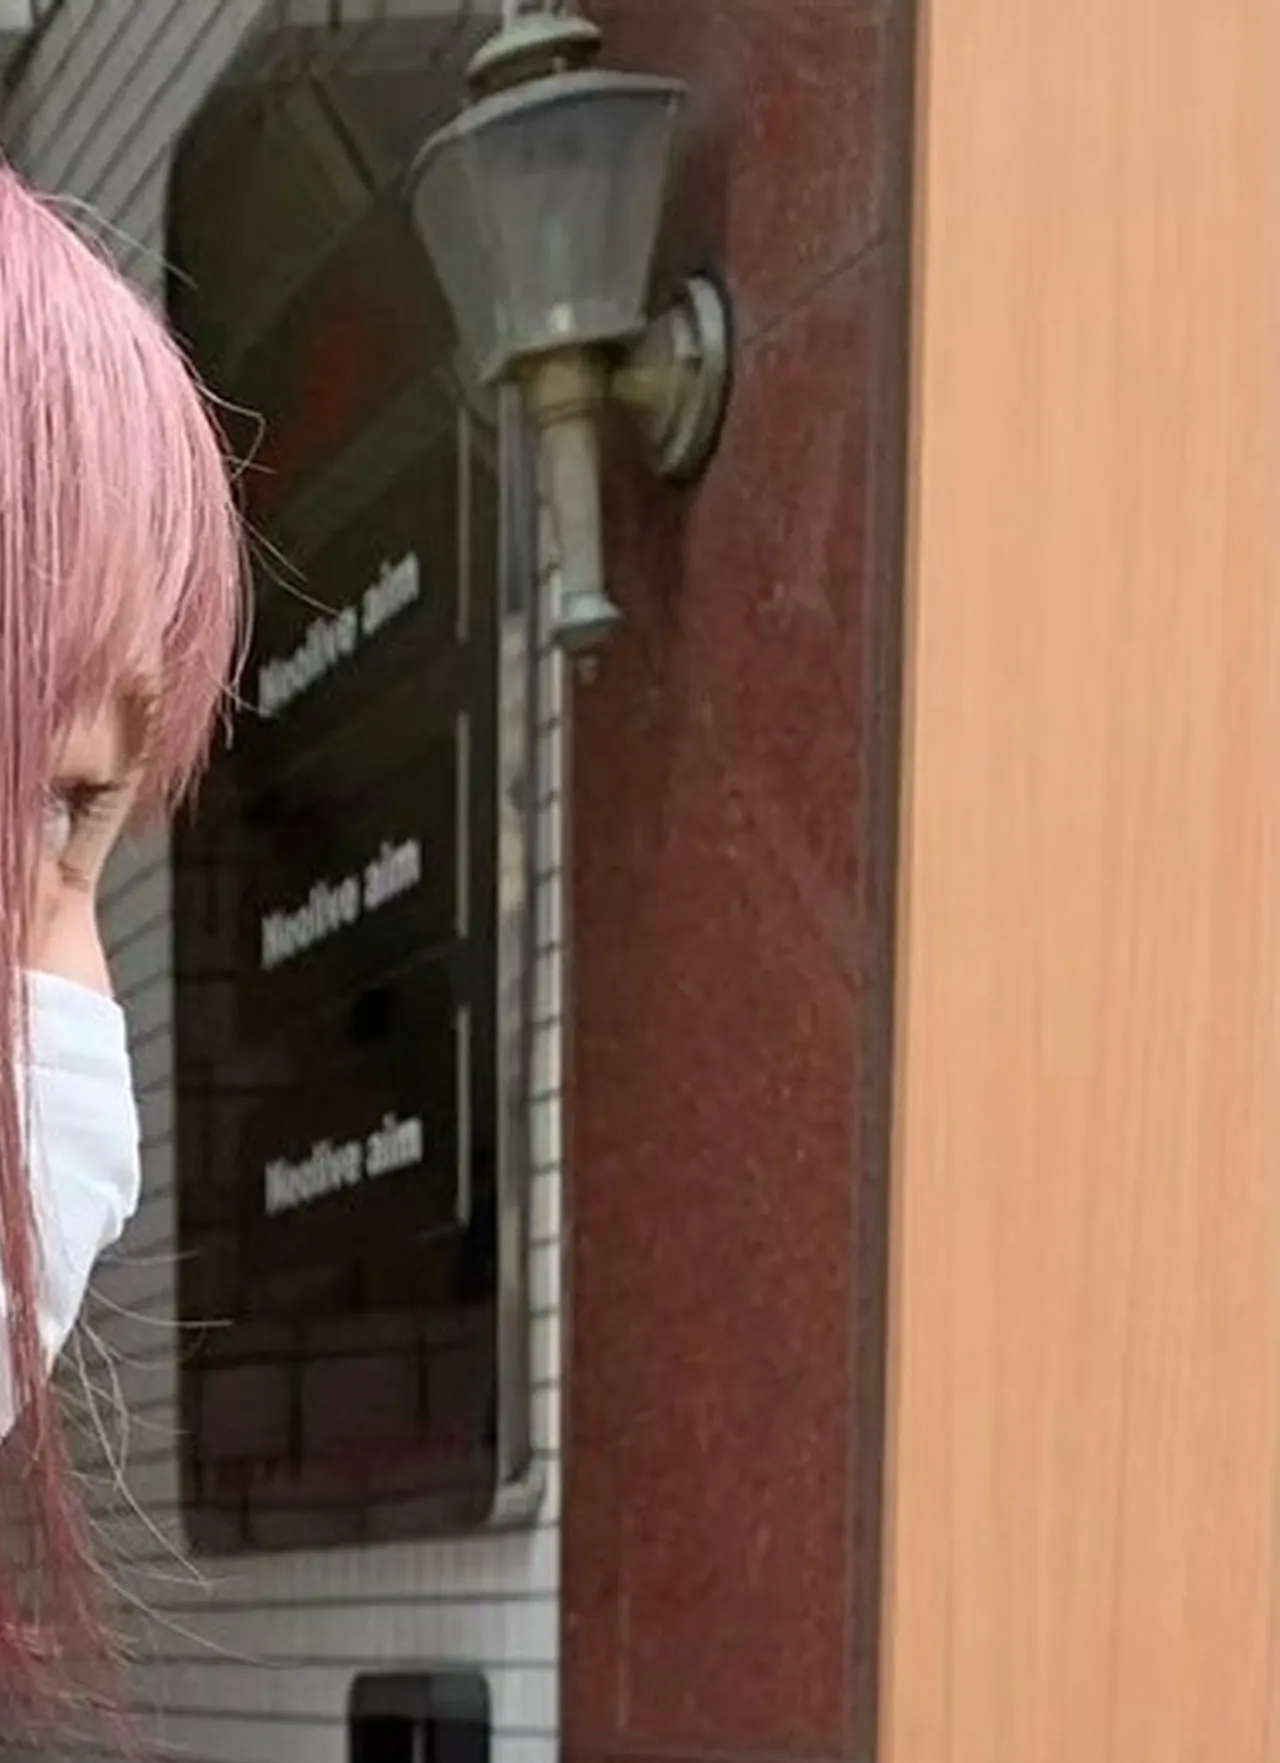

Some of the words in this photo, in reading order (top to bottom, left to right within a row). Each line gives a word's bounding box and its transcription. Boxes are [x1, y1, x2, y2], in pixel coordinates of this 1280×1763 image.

[362, 551, 420, 636] aim
[363, 837, 422, 911] aim
[366, 1111, 423, 1179] aim
